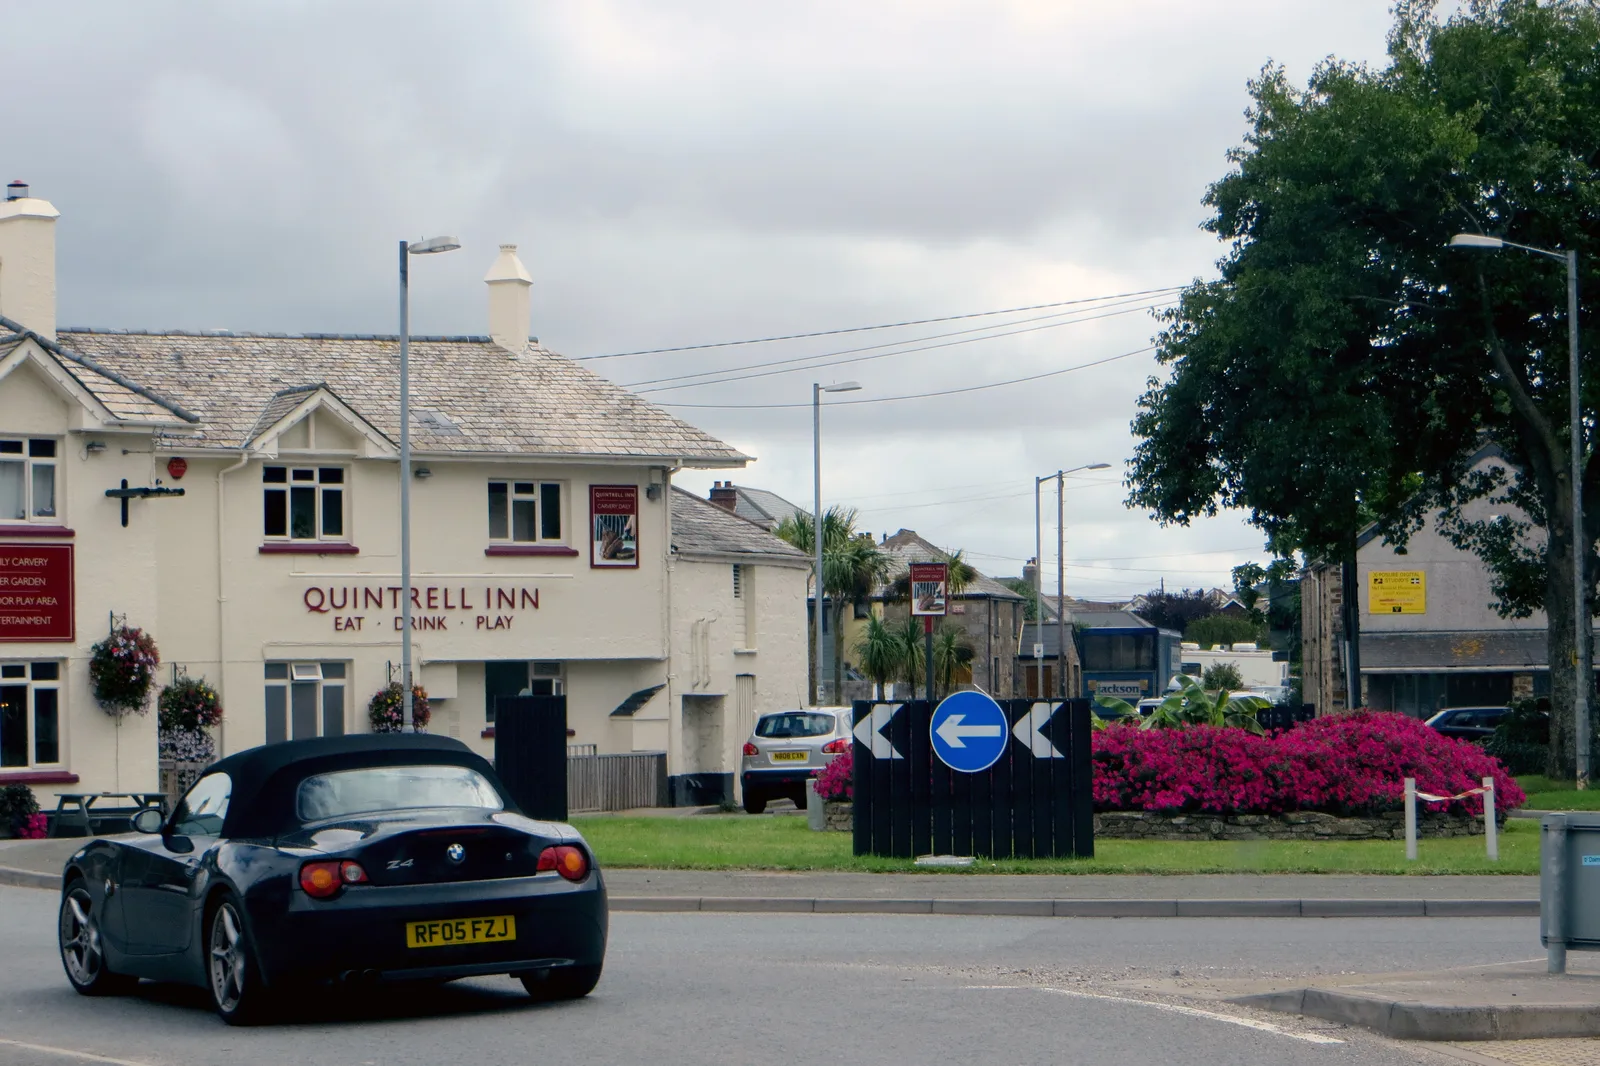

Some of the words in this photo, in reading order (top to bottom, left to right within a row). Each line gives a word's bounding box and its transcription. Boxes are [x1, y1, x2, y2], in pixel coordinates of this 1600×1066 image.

[12, 557, 49, 567] CARVERY
[10, 577, 47, 586] GARDEN
[15, 597, 35, 606] PLAY
[35, 597, 58, 606] AREA
[304, 587, 473, 613] QUINTRELL
[486, 587, 540, 610] INN
[334, 616, 365, 632] EAT
[394, 616, 448, 631] DRINK
[476, 615, 514, 630] PLAY
[386, 858, 415, 870] Z4
[415, 921, 467, 944] RF05
[471, 917, 509, 940] FZJ
